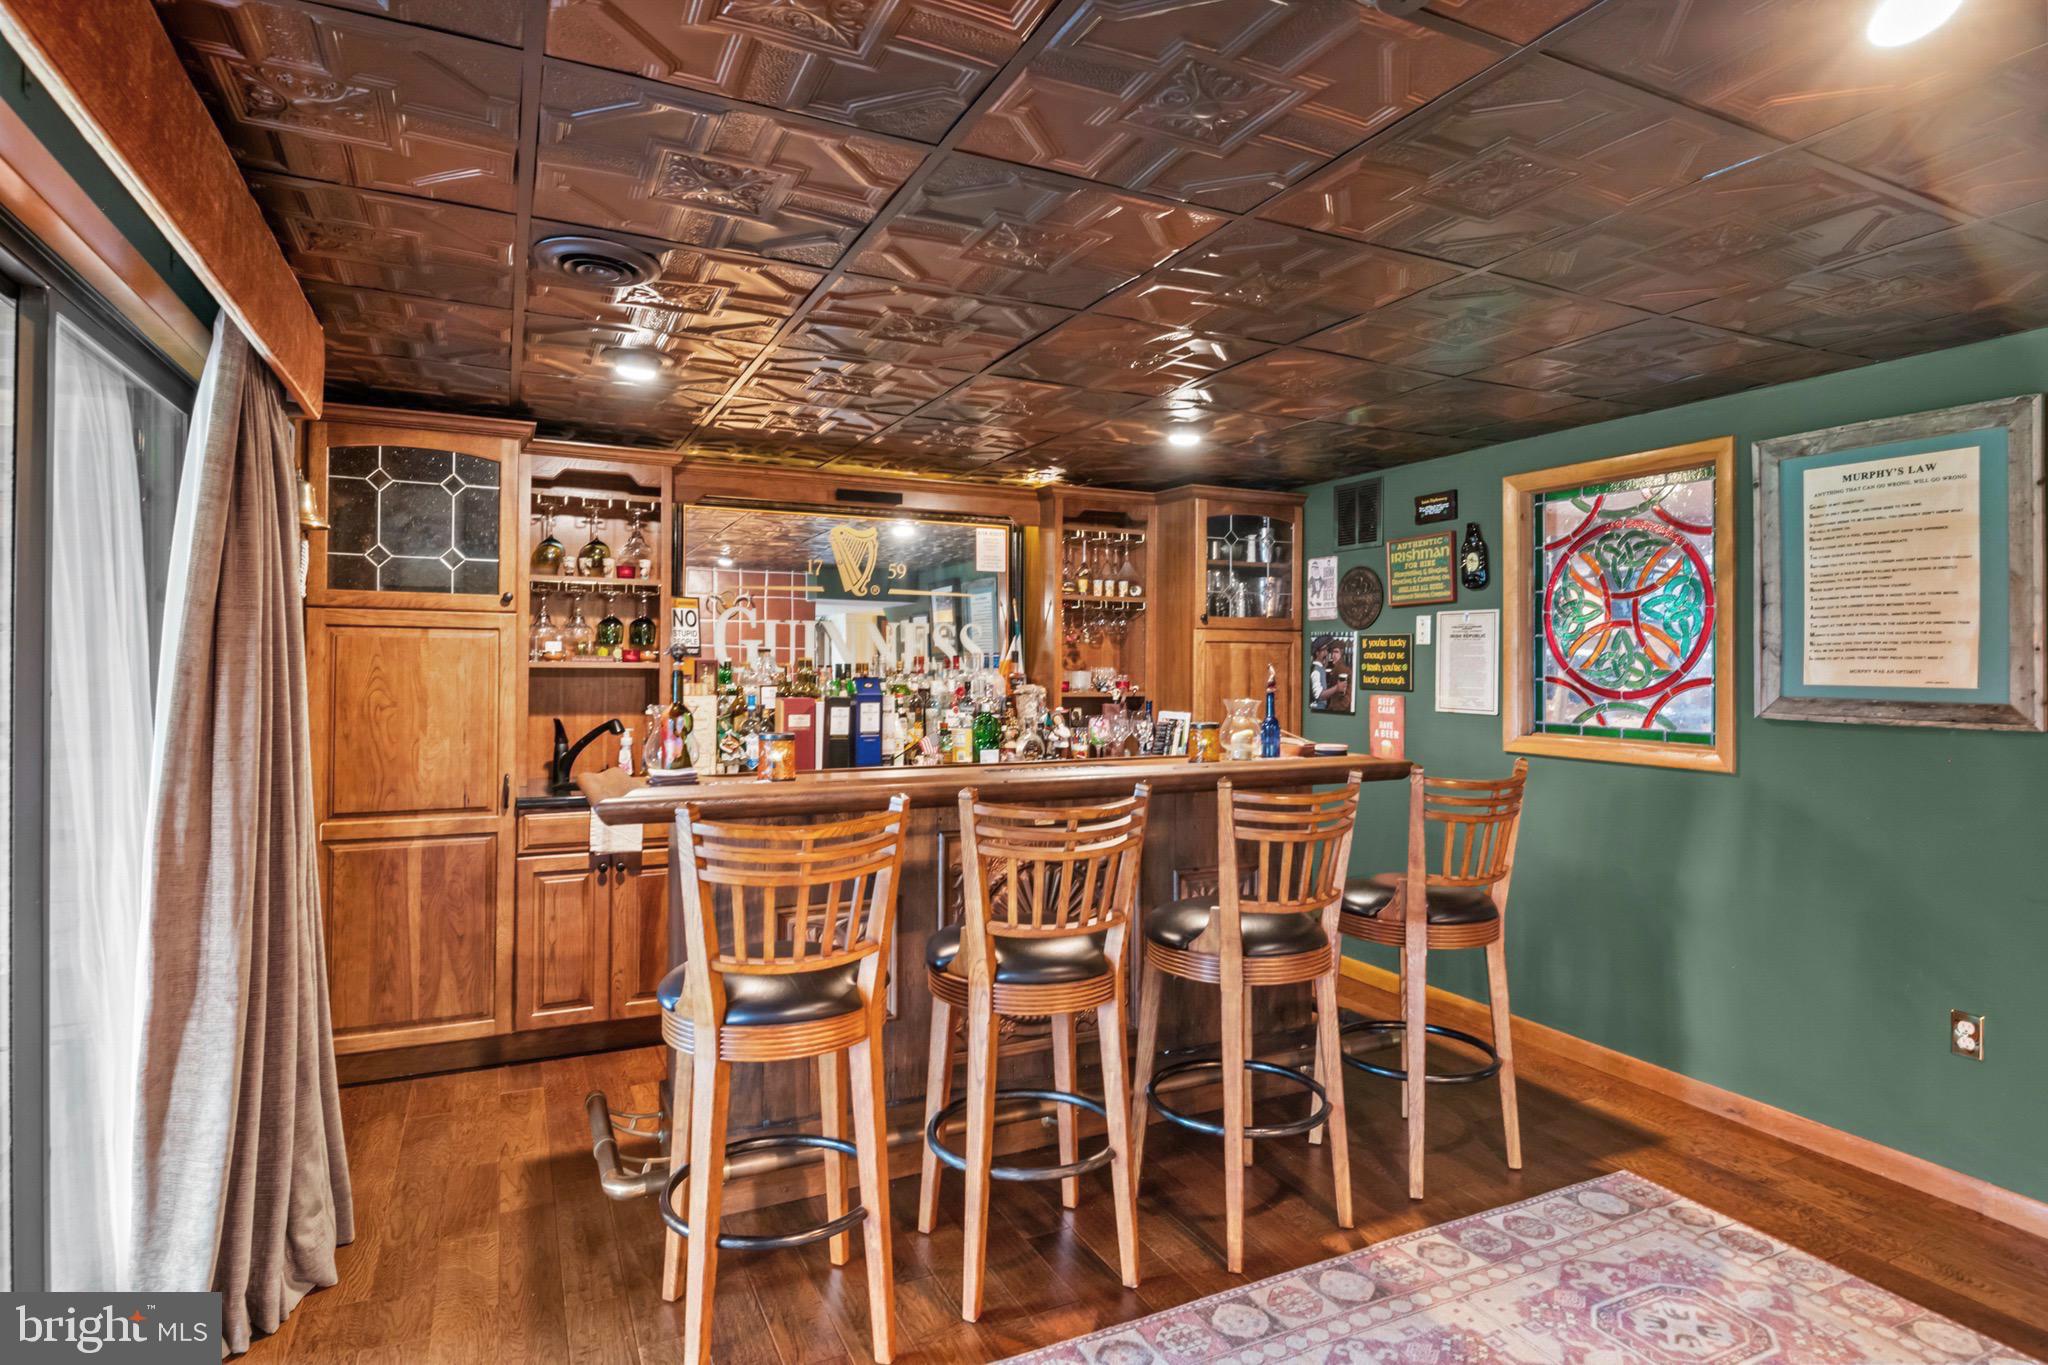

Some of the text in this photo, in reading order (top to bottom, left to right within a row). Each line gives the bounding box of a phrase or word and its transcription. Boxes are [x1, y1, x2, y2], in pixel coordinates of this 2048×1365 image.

[1842, 462, 1937, 483] MURPHY'S LAW
[1814, 488, 1844, 498] ANYTHING
[1914, 477, 1929, 485] WILL
[1943, 473, 1968, 481] WRONG
[806, 560, 907, 580] 17 59
[673, 609, 697, 628] NO
[672, 629, 698, 638] STUPID
[1389, 639, 1406, 649] lucky
[1364, 651, 1386, 660] enough
[1363, 675, 1380, 685] lucky
